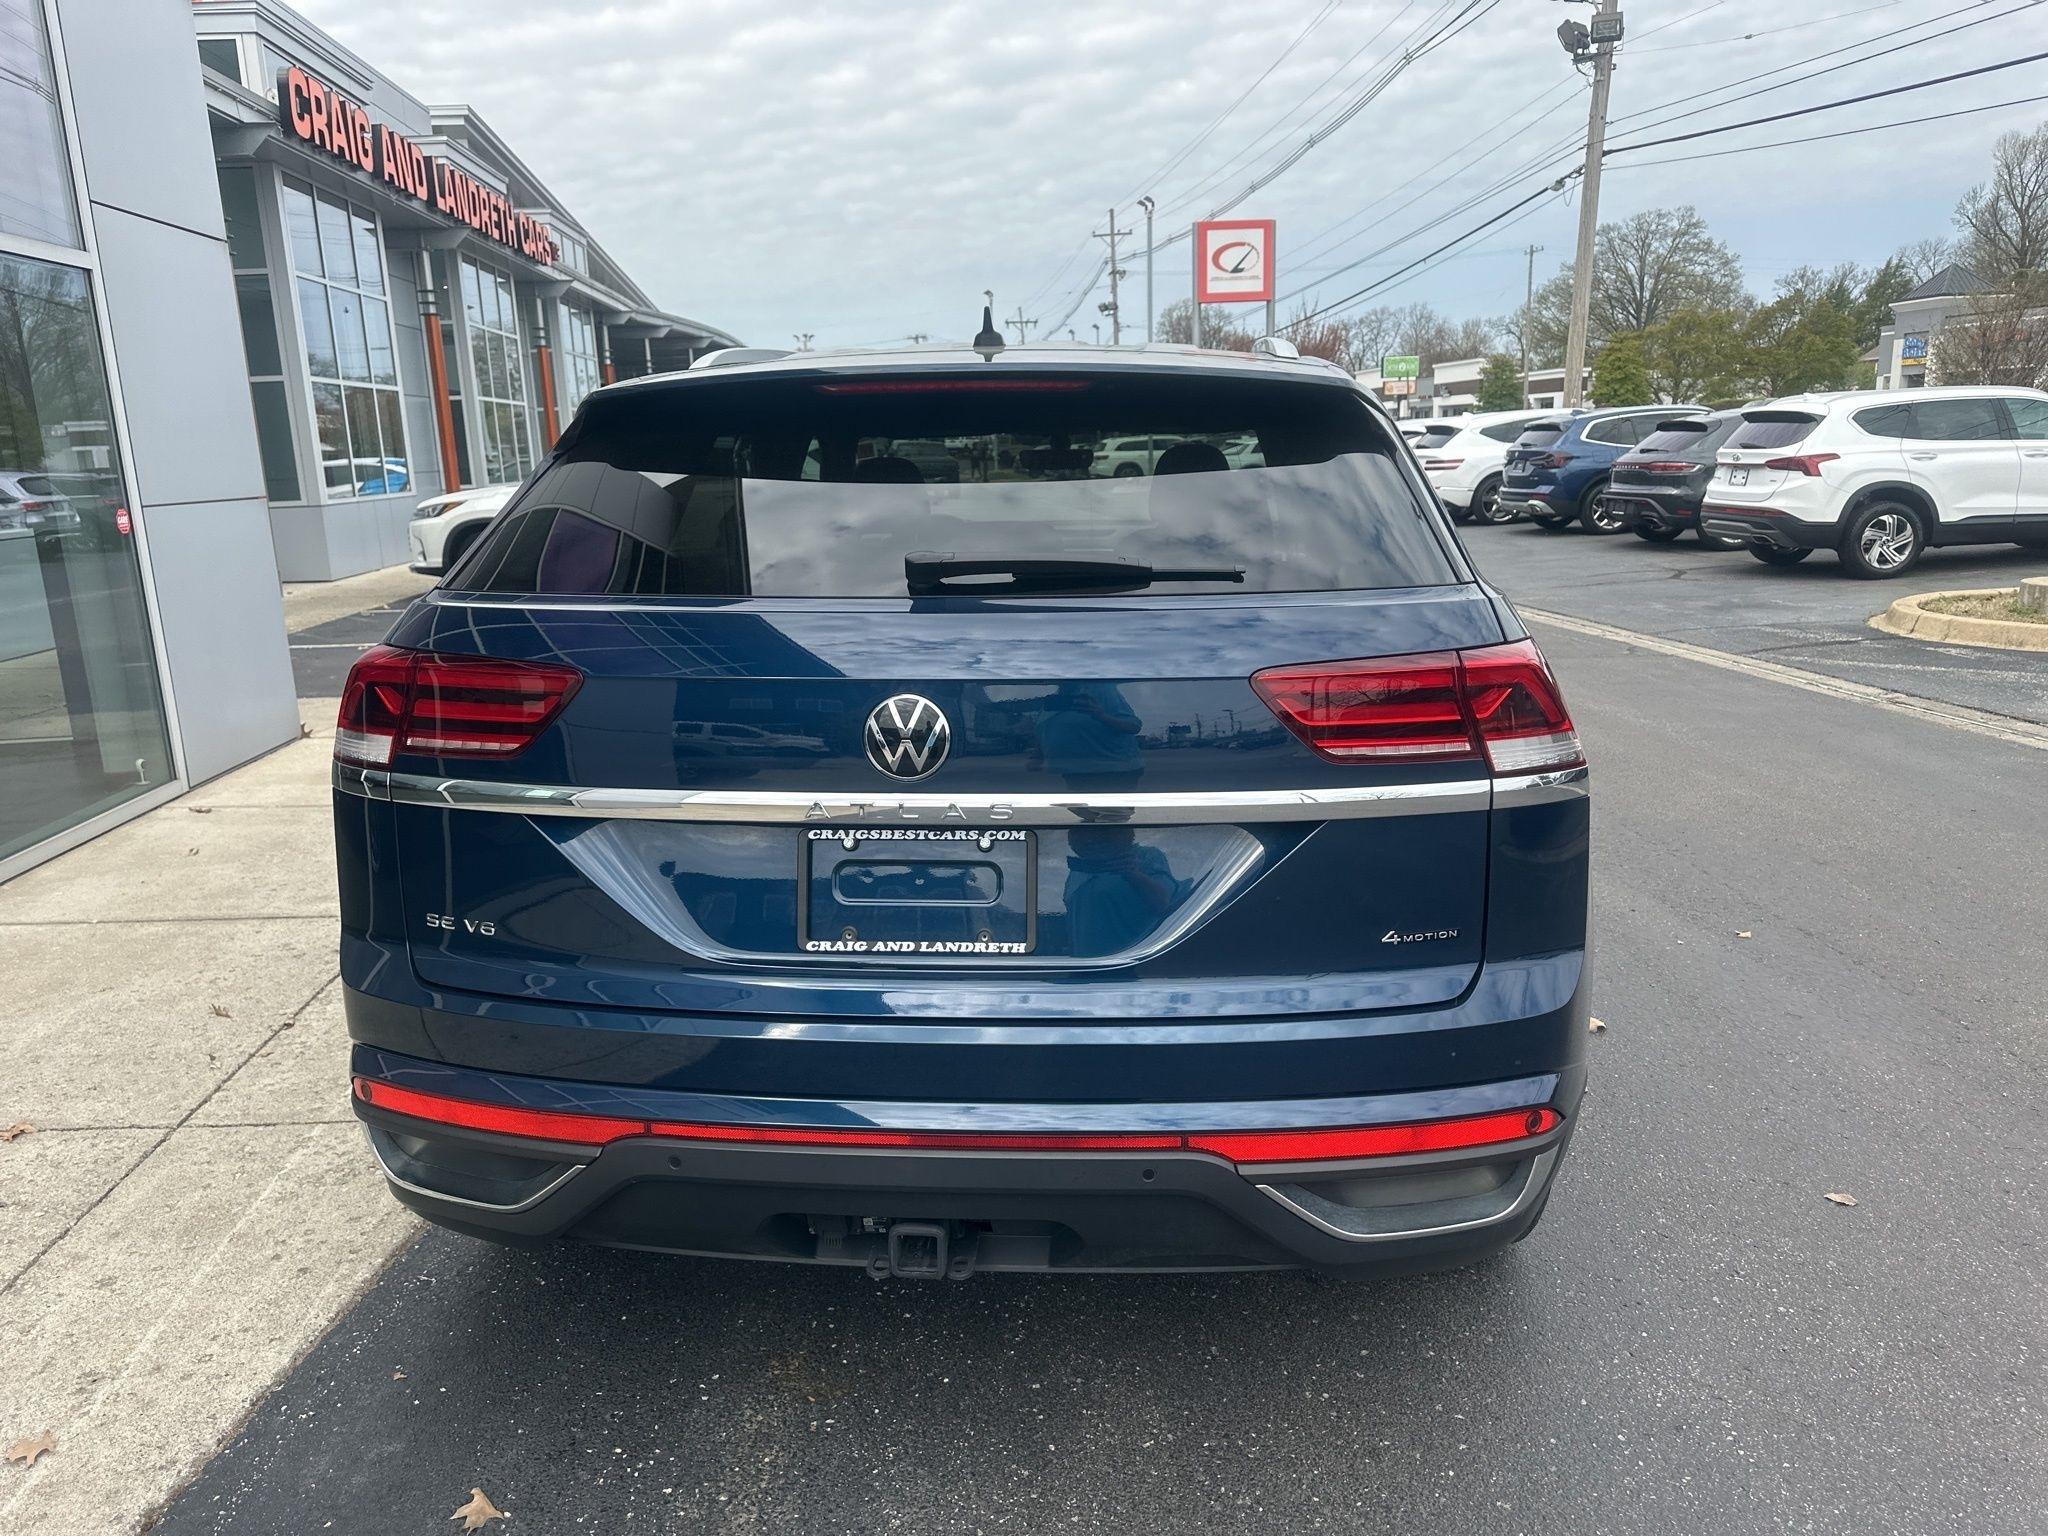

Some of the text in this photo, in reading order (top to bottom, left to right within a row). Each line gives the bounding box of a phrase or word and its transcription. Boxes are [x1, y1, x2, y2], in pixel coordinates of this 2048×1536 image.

[288, 66, 553, 266] CRAIG AND LANDRETH CARS
[805, 802, 1014, 820] ATLAS
[808, 829, 1027, 841] CRAIGSBESTCARS.COM
[426, 913, 496, 936] SE V6
[1381, 929, 1458, 945] 4MOTION
[805, 941, 1026, 953] CRAIG AND LANDRETH
